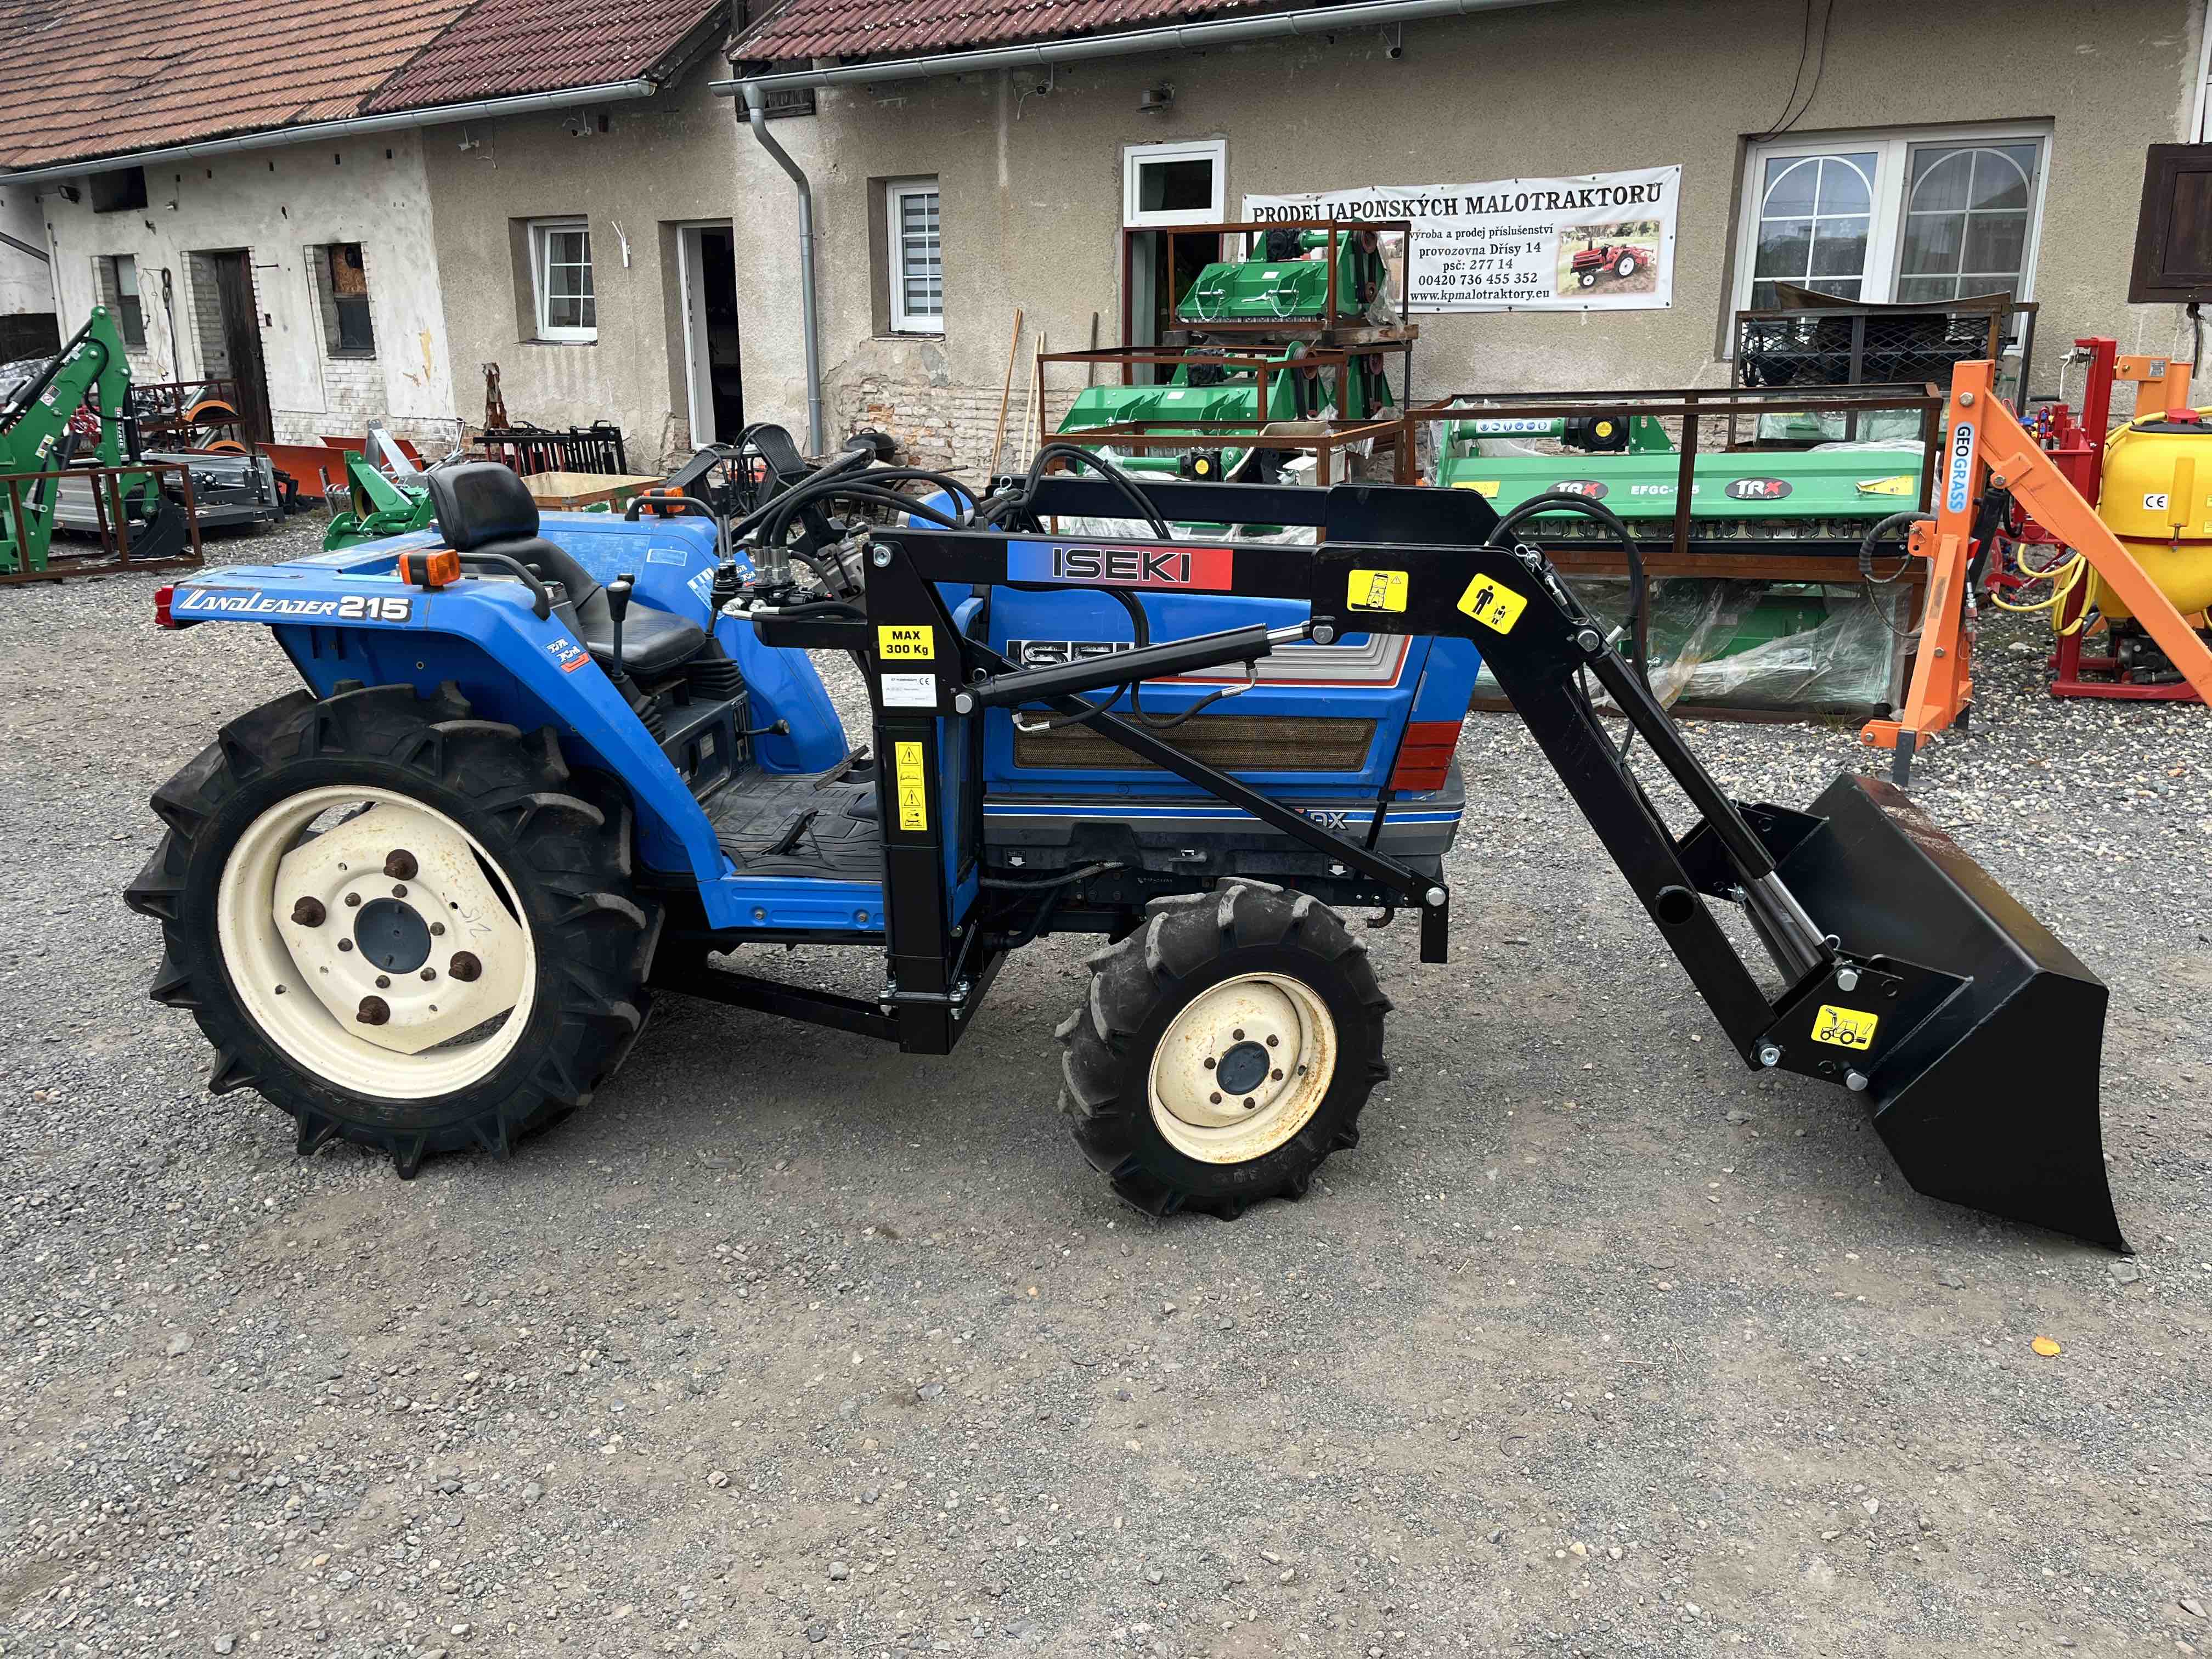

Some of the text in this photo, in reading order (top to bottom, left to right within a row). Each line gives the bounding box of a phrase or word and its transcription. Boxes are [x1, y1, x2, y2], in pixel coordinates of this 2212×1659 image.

[1252, 182, 1663, 222] PRODEJ JAPONSKÝCH MALOTRAKTORŮ
[1409, 229, 1443, 241] výroba
[1455, 227, 1485, 240] prodej
[1489, 223, 1554, 239] příslušenství
[1419, 242, 1541, 259] provozovna Dřísy 14
[1443, 258, 1513, 273] psč: 277 14
[1419, 273, 1538, 285] 00420 736 455 352
[1410, 289, 1550, 302] www.kpmalotraktory.eu
[1949, 426, 1971, 510] GEOGRASS
[1556, 482, 1600, 496] TRX
[1736, 480, 1782, 495] TRX
[1053, 548, 1191, 583] ISEKI
[337, 595, 411, 620] 215
[892, 631, 921, 640] MAX
[886, 645, 929, 656] 300 Kg
[1007, 640, 1136, 670] ISE
